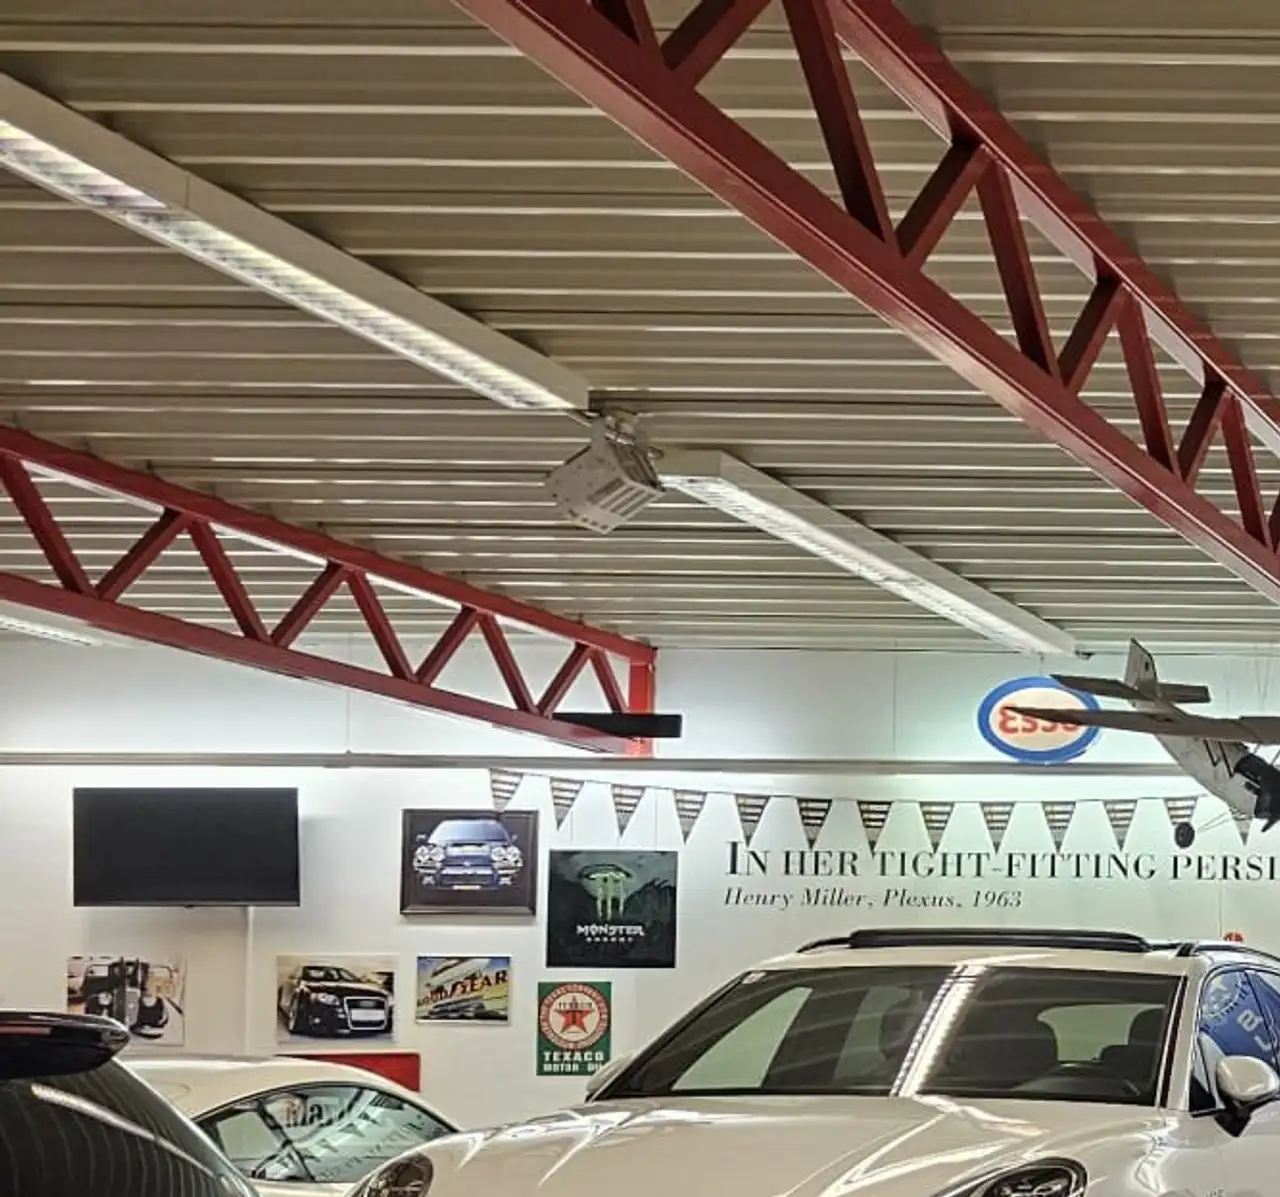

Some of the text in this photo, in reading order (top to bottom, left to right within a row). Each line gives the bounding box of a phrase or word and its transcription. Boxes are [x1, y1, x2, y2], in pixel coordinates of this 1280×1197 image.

[784, 850, 858, 877] HER
[872, 850, 1156, 879] TIGHT-FITTING
[724, 886, 794, 911] Henry
[801, 887, 874, 908] Miller,
[973, 889, 1022, 908] 1963
[576, 924, 644, 936] MONSTER
[543, 1051, 604, 1061] TEXACO
